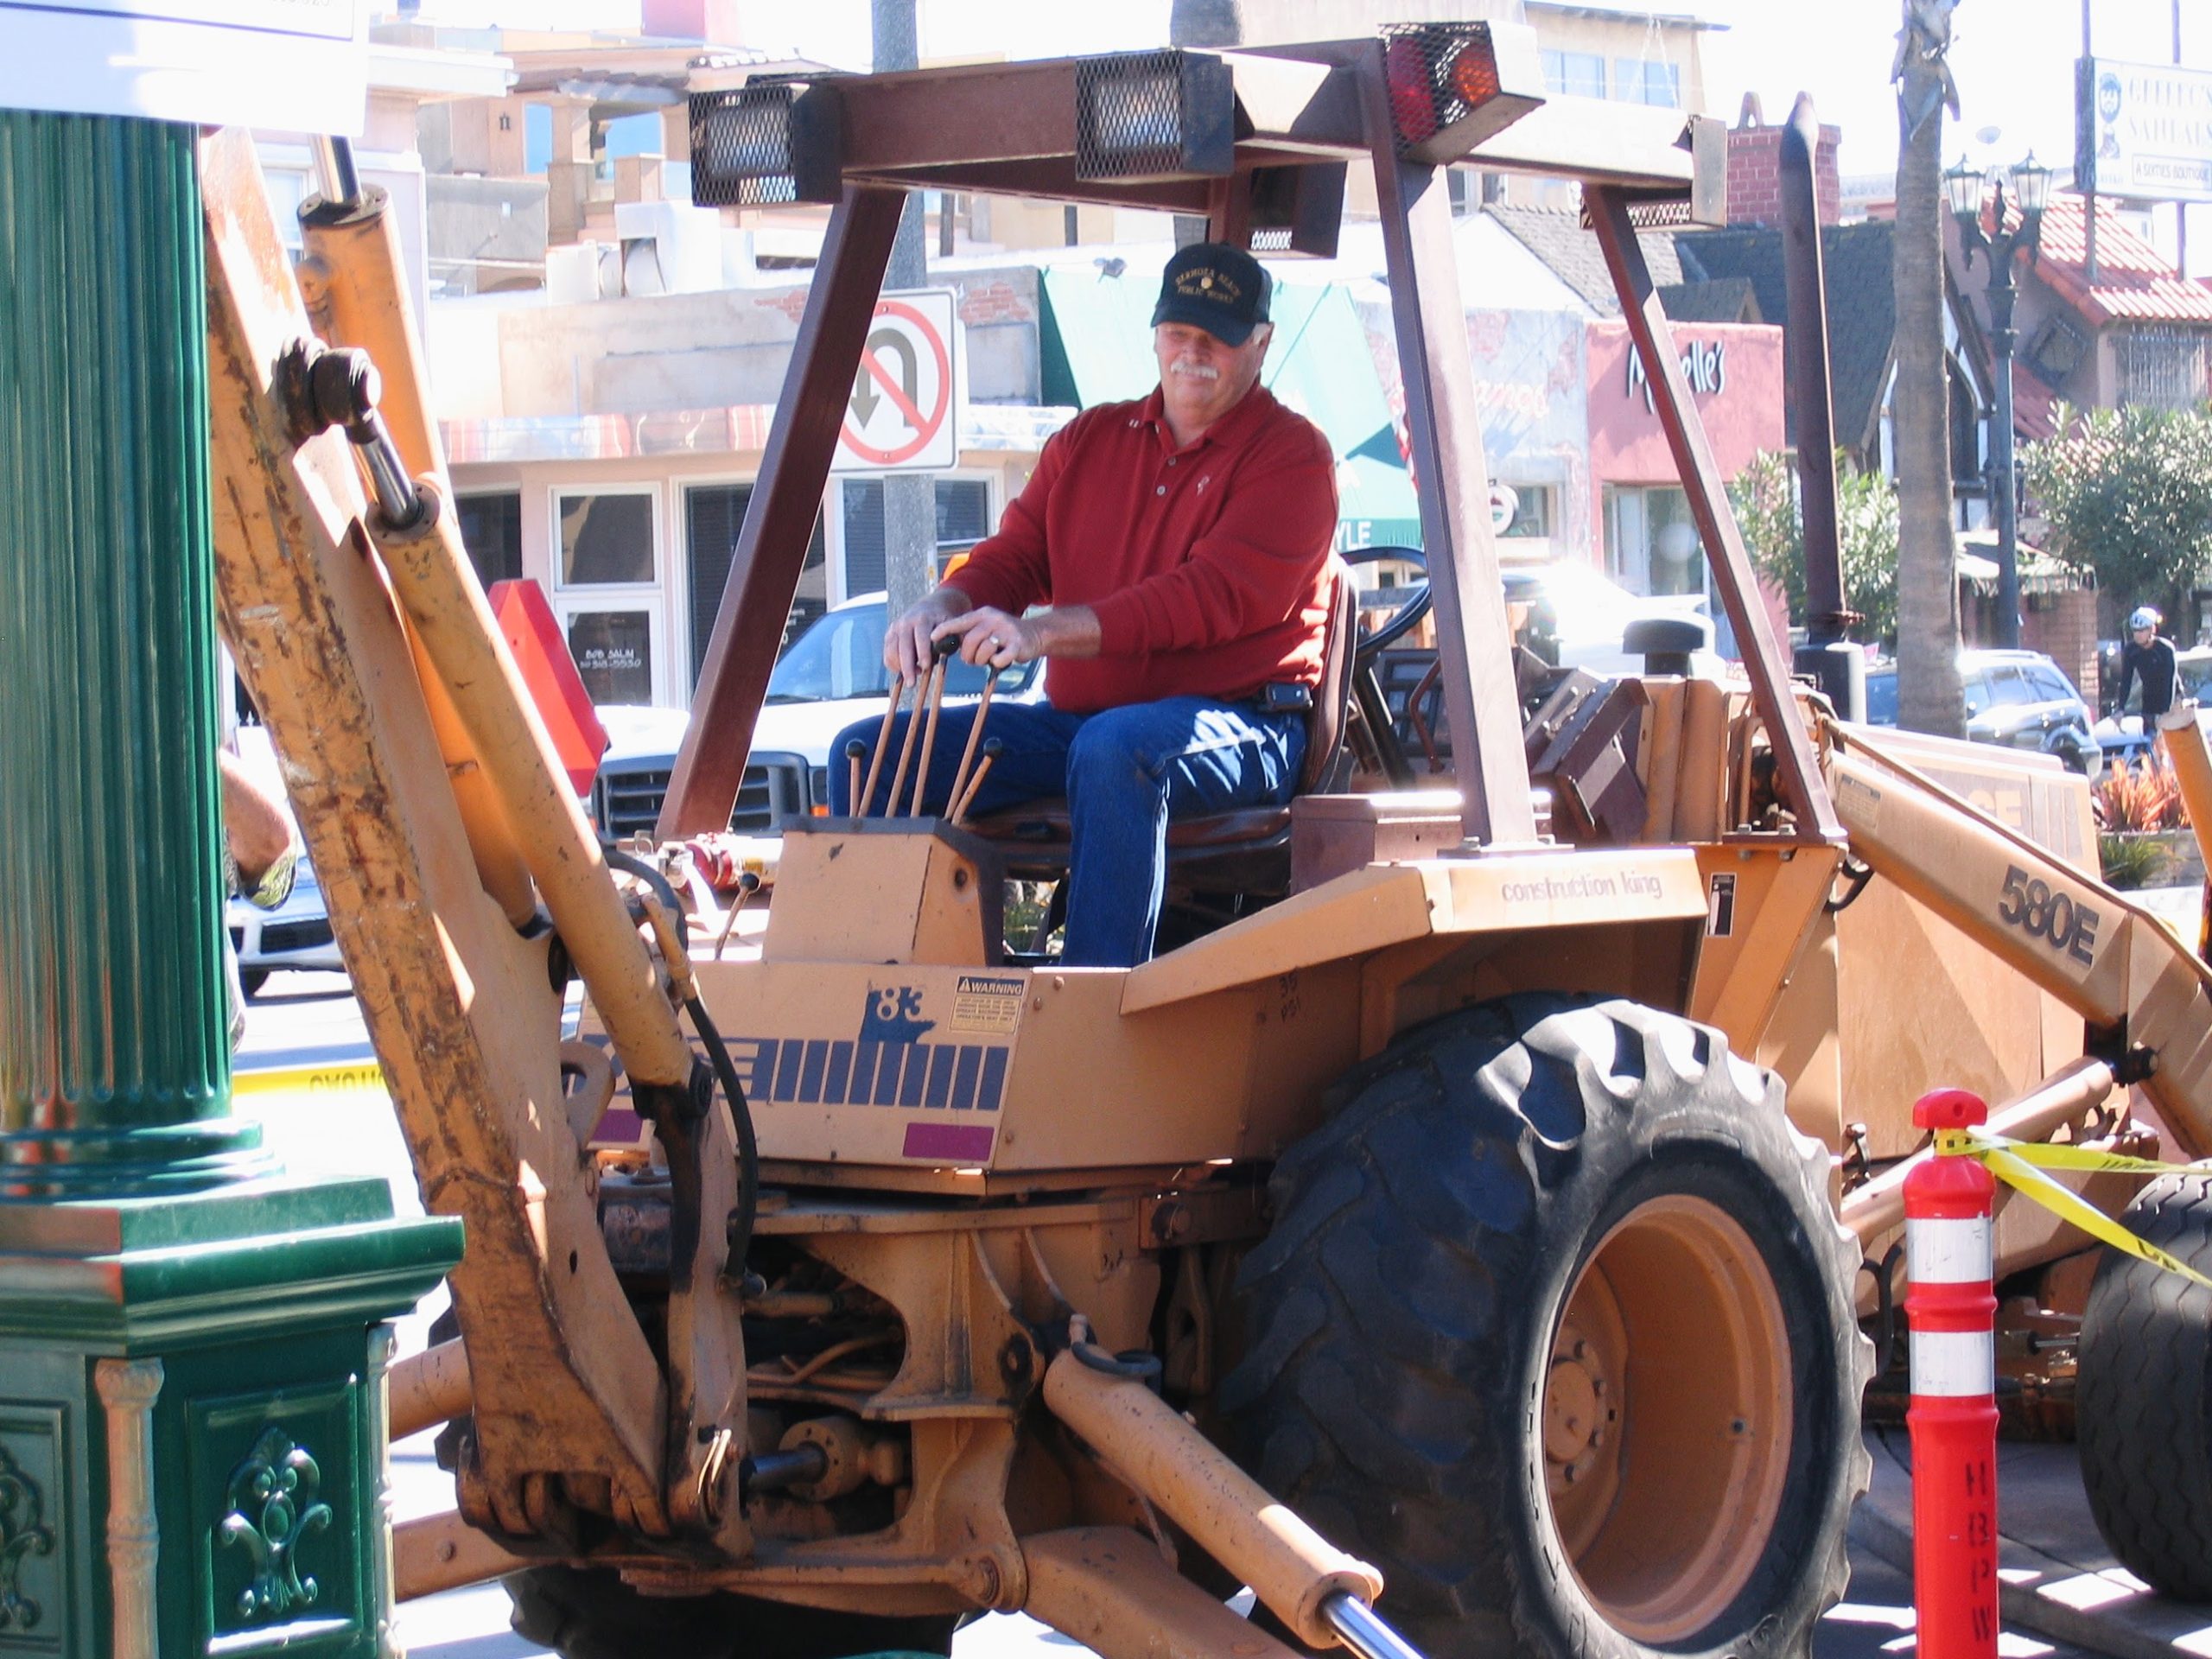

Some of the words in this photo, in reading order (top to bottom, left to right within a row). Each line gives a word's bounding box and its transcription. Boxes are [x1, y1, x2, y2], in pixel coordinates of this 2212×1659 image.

[1501, 875, 1617, 901] construction
[1620, 870, 1663, 900] king
[1998, 864, 2101, 968] 580E
[971, 982, 1023, 995] WARNING
